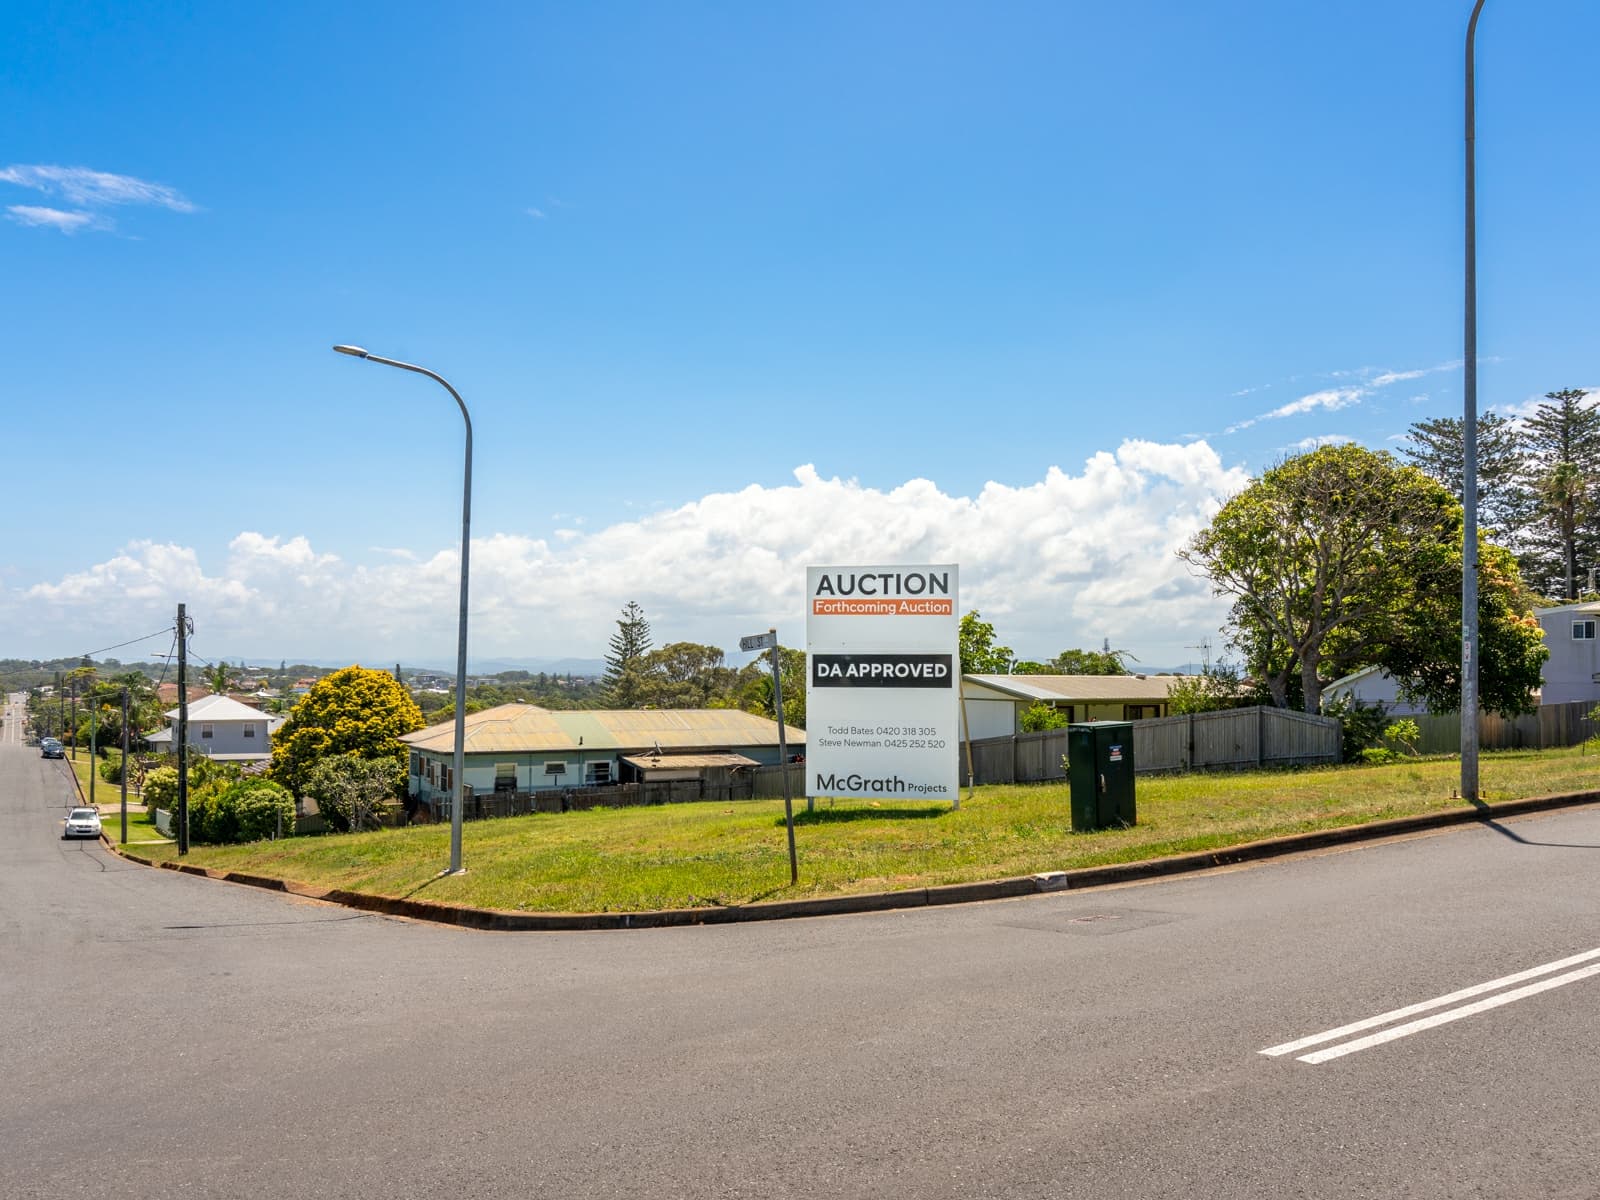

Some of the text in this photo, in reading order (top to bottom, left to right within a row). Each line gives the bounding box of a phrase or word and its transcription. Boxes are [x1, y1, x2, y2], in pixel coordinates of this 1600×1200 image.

[816, 573, 948, 595] AUCTION
[815, 601, 950, 615] Forthcoming Auction
[817, 663, 947, 678] DA APPROVED
[828, 726, 936, 736] Todd Bates 0420 318 305
[819, 739, 946, 749] Steve Newman 0425 252 520
[816, 773, 947, 794] McGrath Projects
